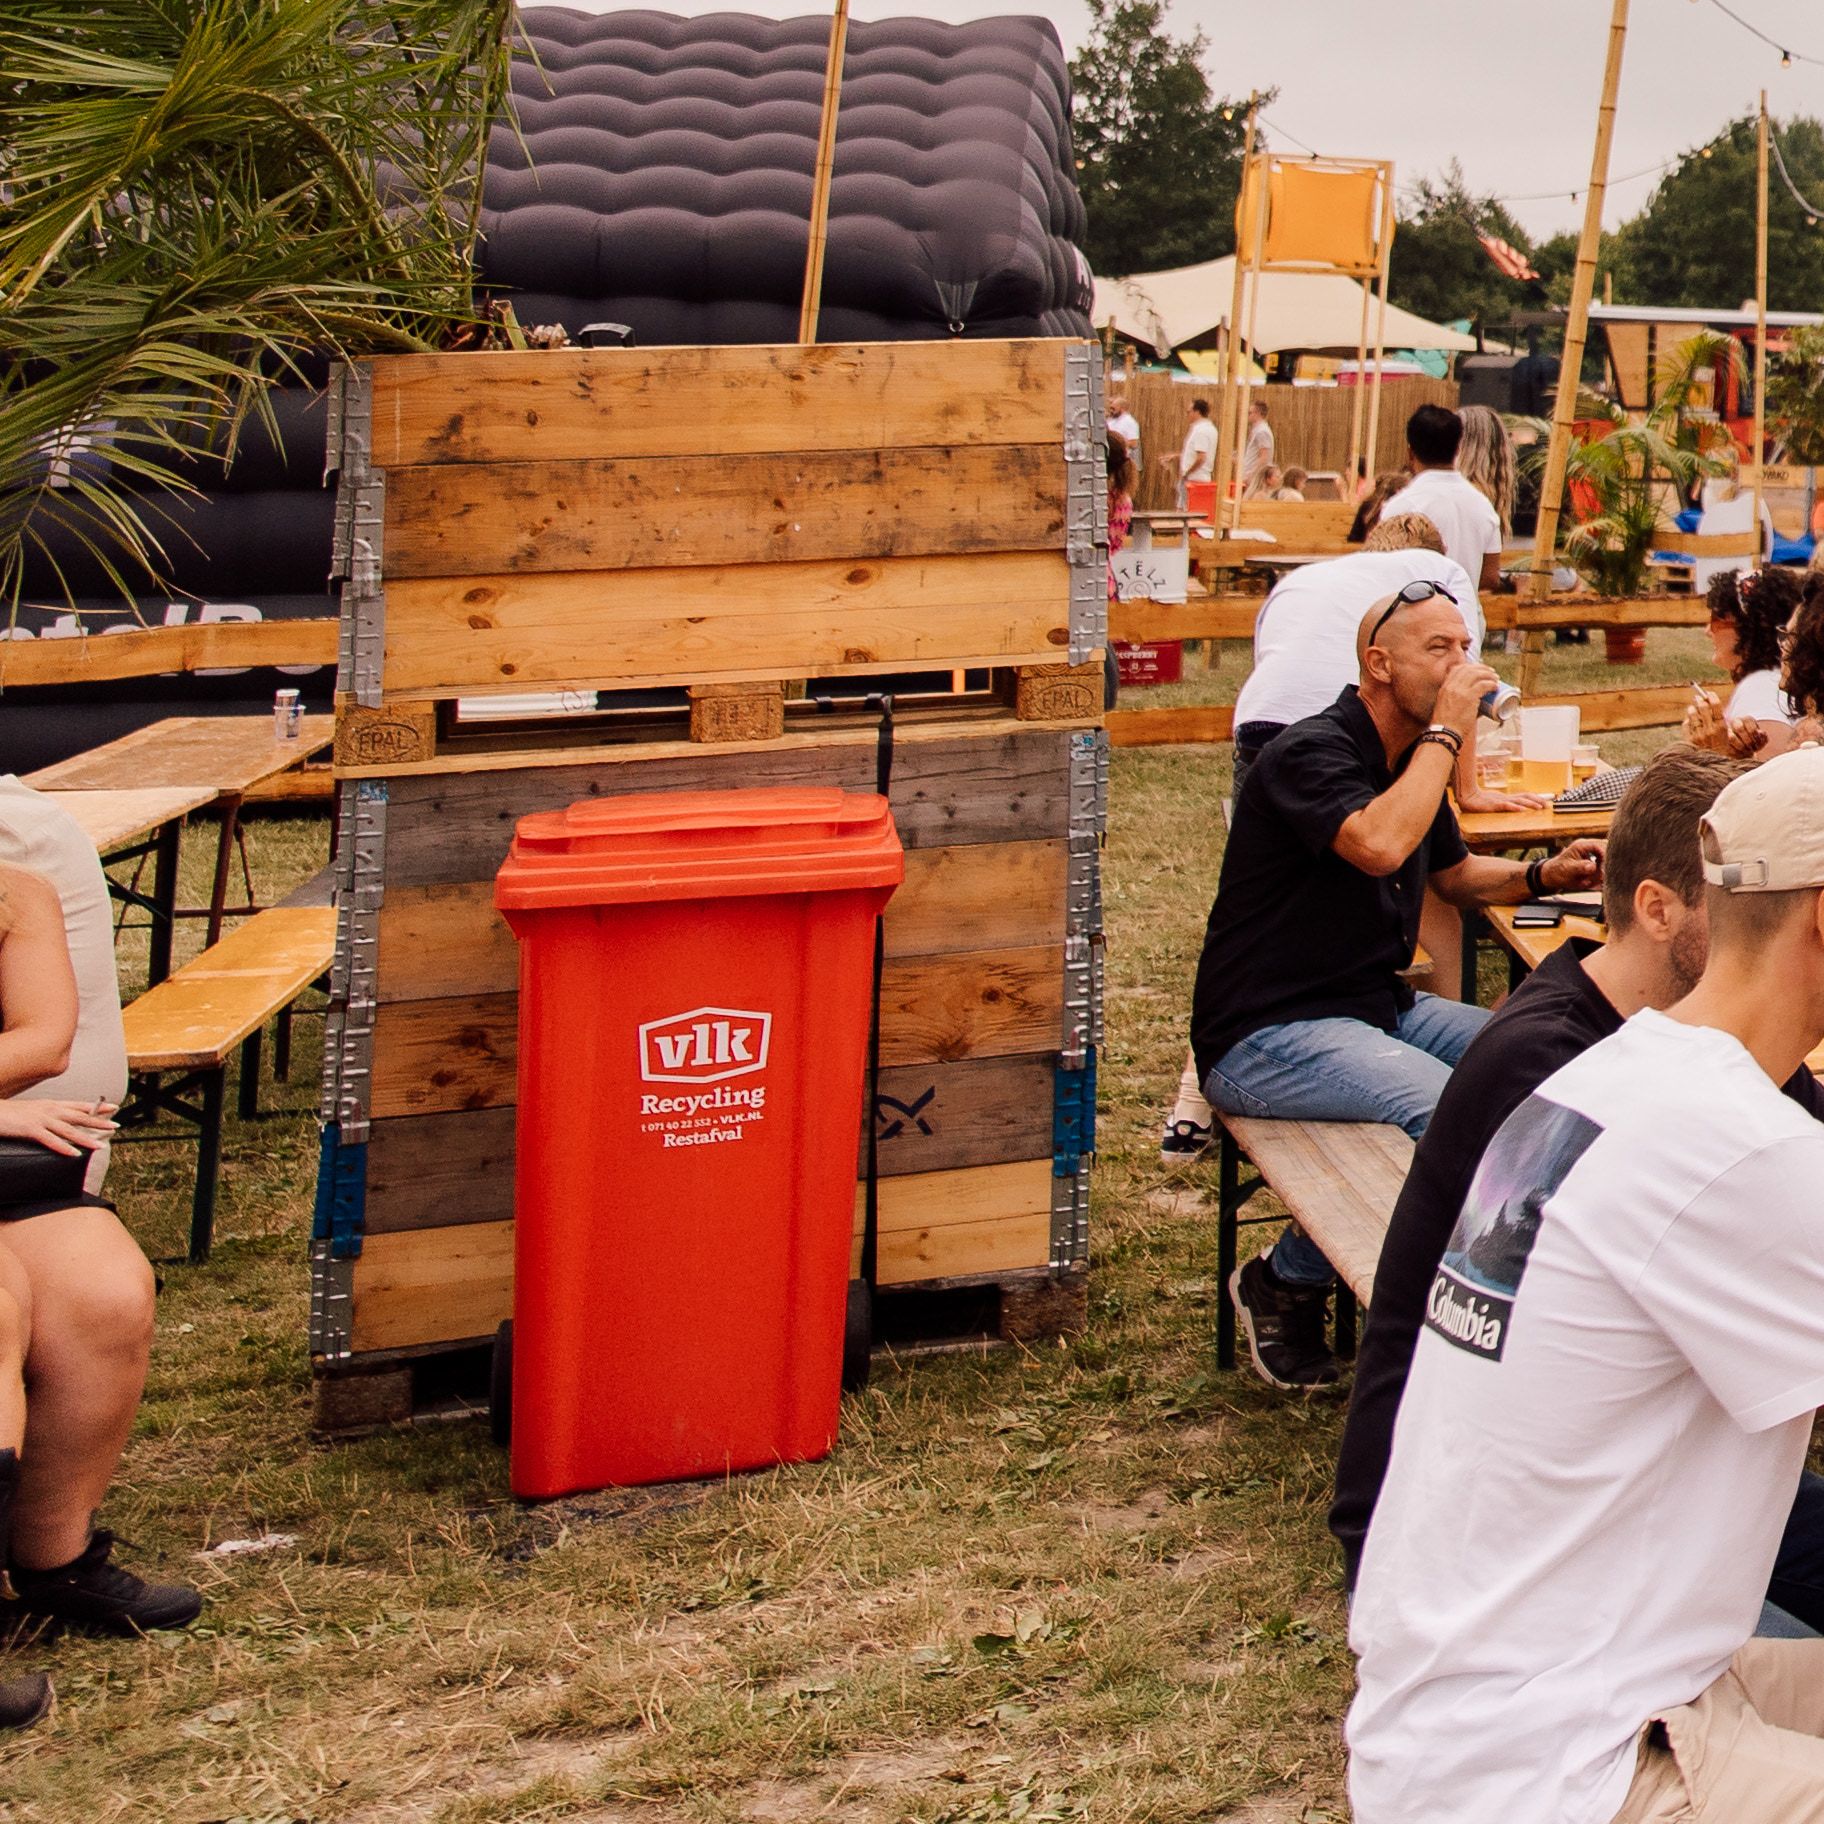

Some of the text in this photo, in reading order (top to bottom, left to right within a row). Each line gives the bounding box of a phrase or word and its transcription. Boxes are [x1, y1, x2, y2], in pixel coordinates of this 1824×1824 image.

[654, 1021, 753, 1069] vlk
[640, 1086, 766, 1116] Recycling
[663, 1125, 743, 1148] Restafval
[1427, 1276, 1501, 1350] Columbia
